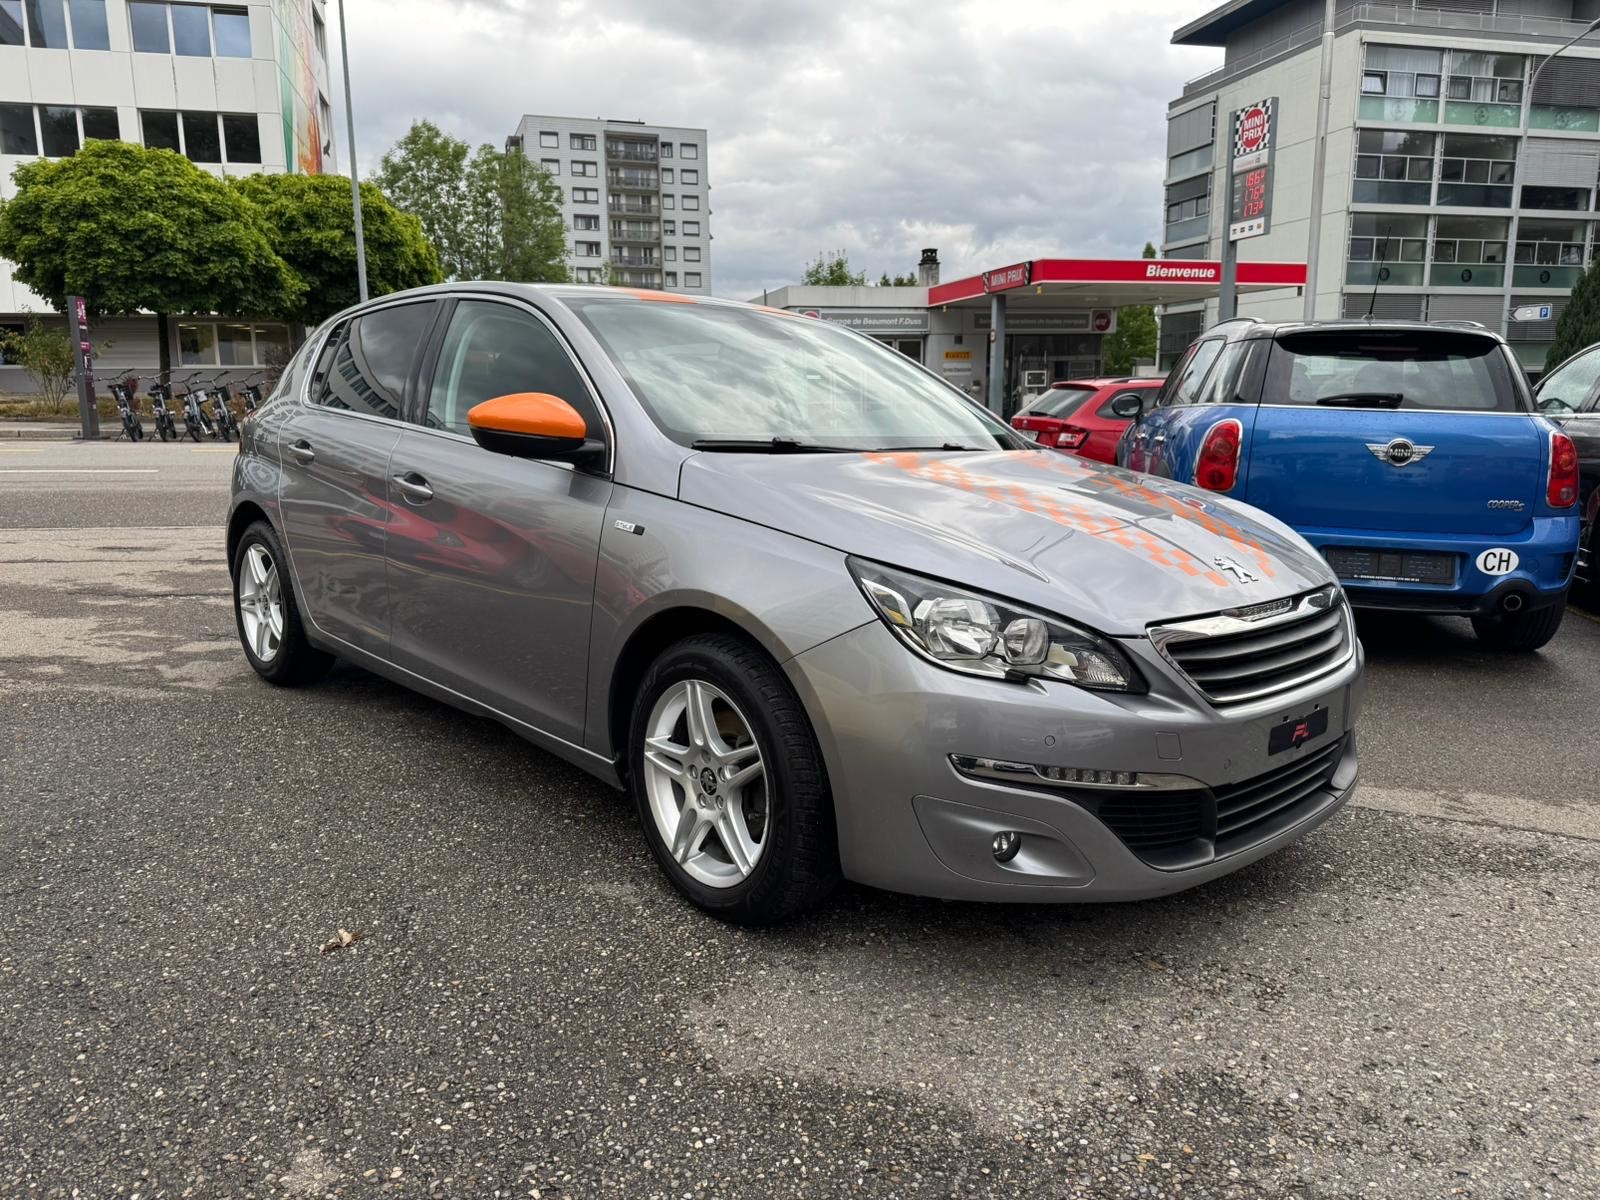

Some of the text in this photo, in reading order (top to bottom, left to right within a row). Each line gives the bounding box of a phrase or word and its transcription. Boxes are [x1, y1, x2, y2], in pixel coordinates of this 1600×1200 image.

[1243, 116, 1263, 131] MINI
[1243, 128, 1263, 142] PRIX
[991, 268, 1023, 287] MINI PRIX
[1146, 264, 1216, 278] Bienvenue
[1390, 448, 1411, 457] MINI
[1487, 499, 1520, 510] COOPER
[1483, 551, 1511, 572] CH
